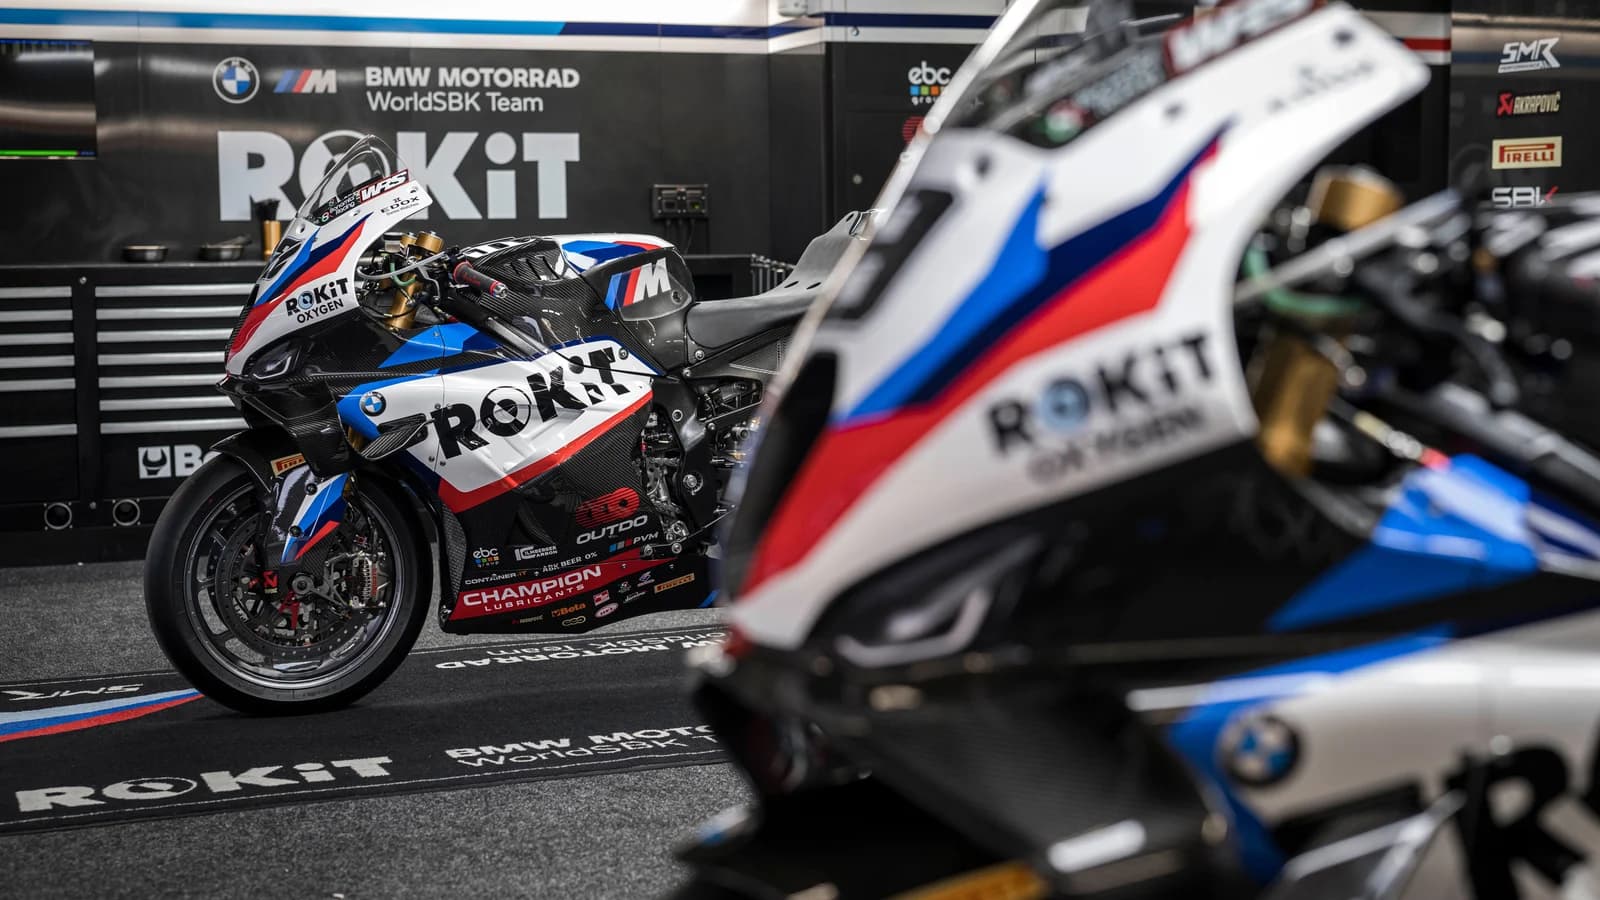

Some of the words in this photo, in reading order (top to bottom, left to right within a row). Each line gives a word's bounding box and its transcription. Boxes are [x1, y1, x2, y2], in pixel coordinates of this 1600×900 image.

[1500, 37, 1560, 68] SMR
[365, 67, 431, 87] BMW
[439, 68, 580, 88] MOTORRAD
[908, 60, 951, 85] ebc
[366, 91, 481, 112] WorldSBK
[486, 92, 544, 112] Team
[1499, 143, 1555, 163] PIRELLI
[218, 130, 580, 221] ROKiT
[361, 171, 407, 201] WRS
[633, 257, 672, 304] M
[285, 278, 349, 316] ROKiT
[297, 299, 344, 324] OXYGEN
[430, 347, 630, 459] ROKiT
[576, 515, 648, 544] OUTDO
[633, 531, 659, 545] PVM
[473, 547, 499, 559] ebc
[463, 566, 602, 607] CHAMPION
[484, 584, 585, 612] LUBRICANTS
[592, 632, 732, 648] orldSBK
[436, 643, 670, 670] MOTORRAD
[446, 738, 571, 758] BMW
[457, 738, 688, 767] WorldSBK
[15, 756, 393, 813] ROKiT
